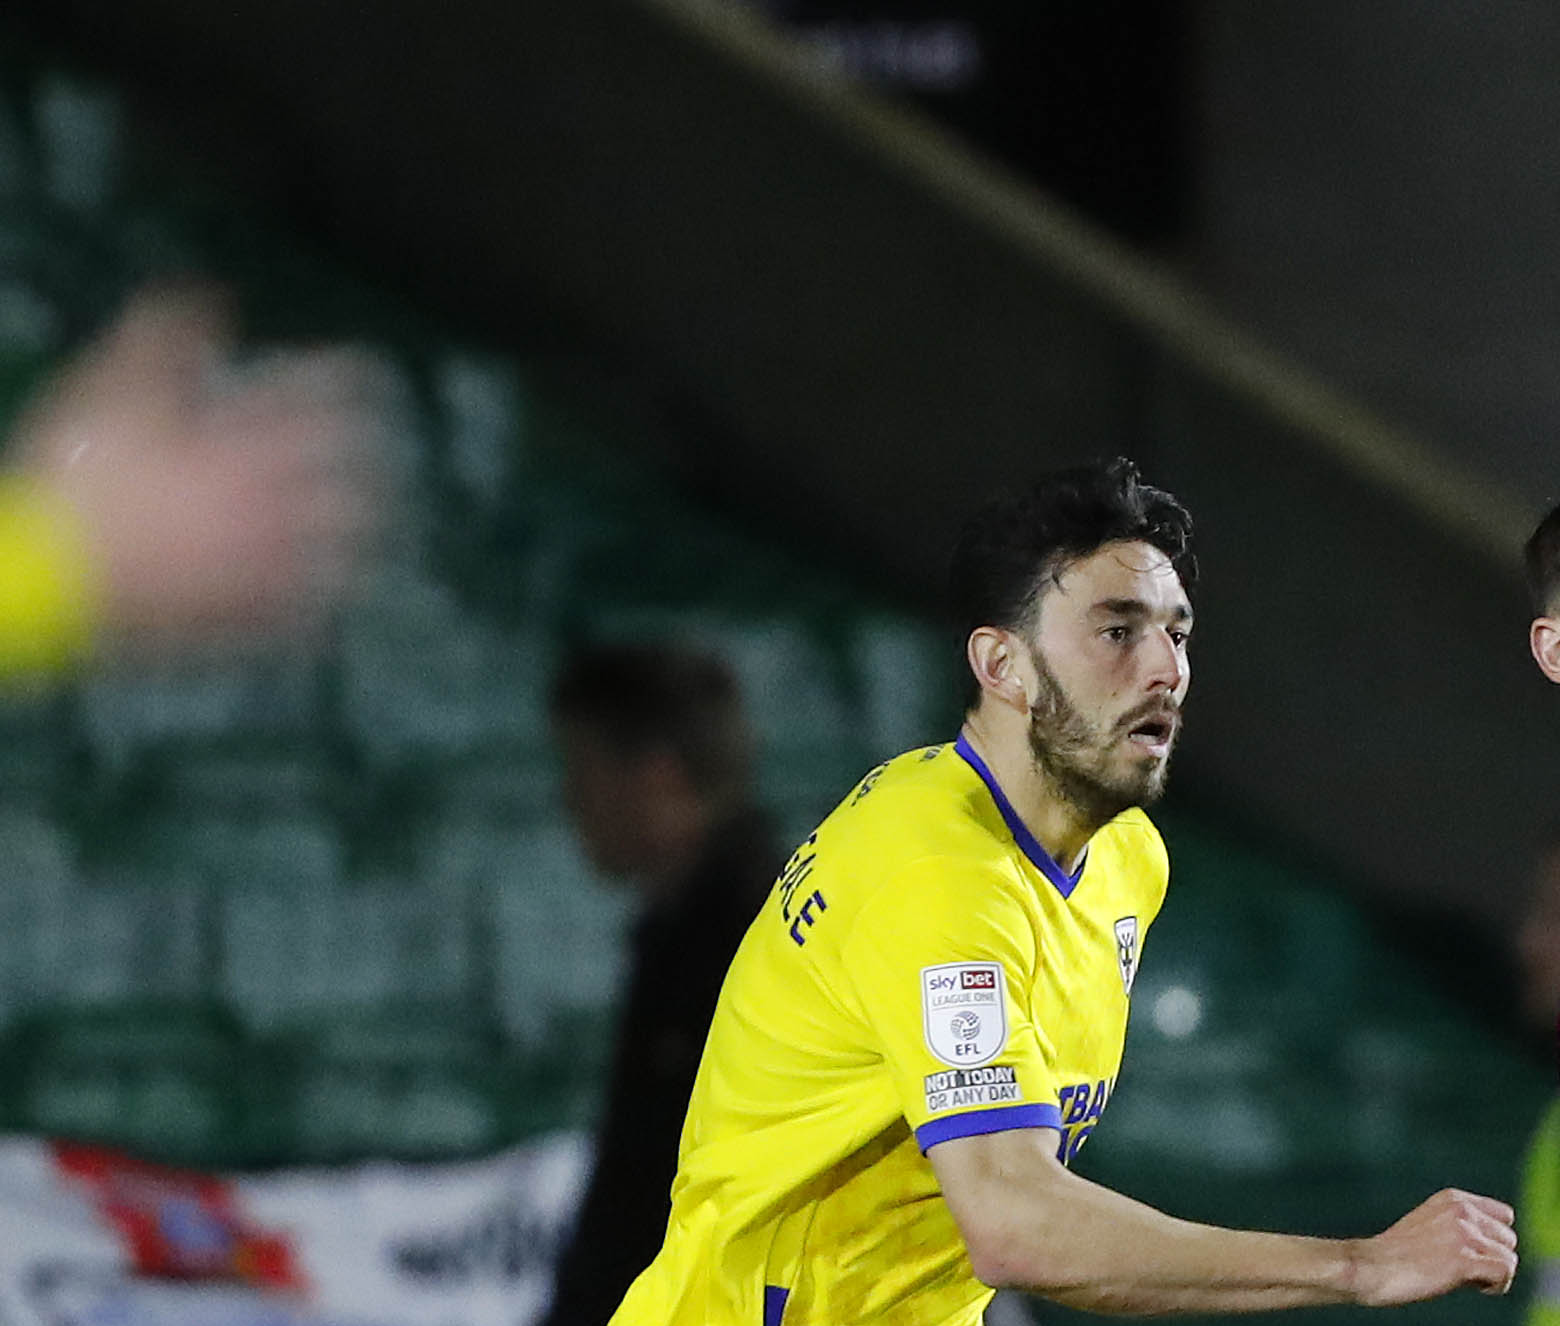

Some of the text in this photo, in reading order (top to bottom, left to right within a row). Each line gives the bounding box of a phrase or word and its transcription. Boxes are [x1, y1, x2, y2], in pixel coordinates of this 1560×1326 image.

[929, 972, 993, 990] sky bet
[955, 1043, 981, 1056] EFL
[926, 1066, 1015, 1094] NOT TODAY
[951, 1087, 984, 1105] ANY
[988, 1084, 1018, 1102] DAY
